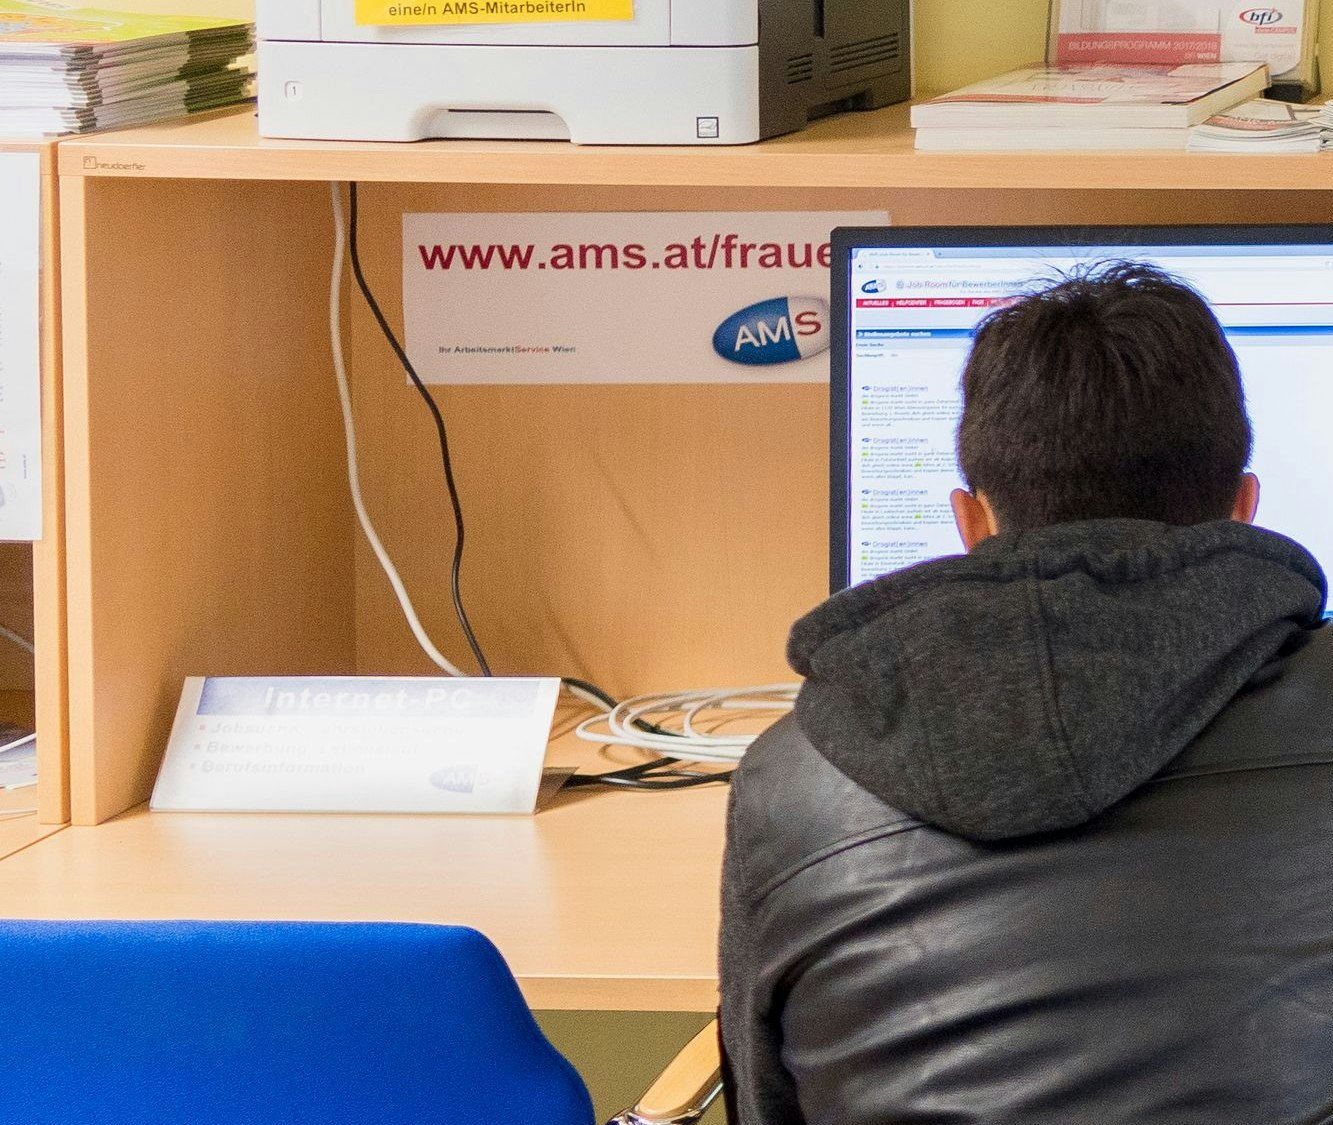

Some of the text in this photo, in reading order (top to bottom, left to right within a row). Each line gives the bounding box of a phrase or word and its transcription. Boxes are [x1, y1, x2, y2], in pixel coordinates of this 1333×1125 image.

[389, 0, 585, 15] eine/n AMS-MitarbeiterIn
[1250, 10, 1276, 25] bfi
[1067, 40, 1172, 52] BILDUNGSPROGRAMM
[292, 86, 298, 95] 1
[733, 311, 822, 352] AMS
[266, 687, 472, 710] Internet-PC
[202, 761, 366, 774] Berufsinformation
[444, 770, 490, 786] AMS
